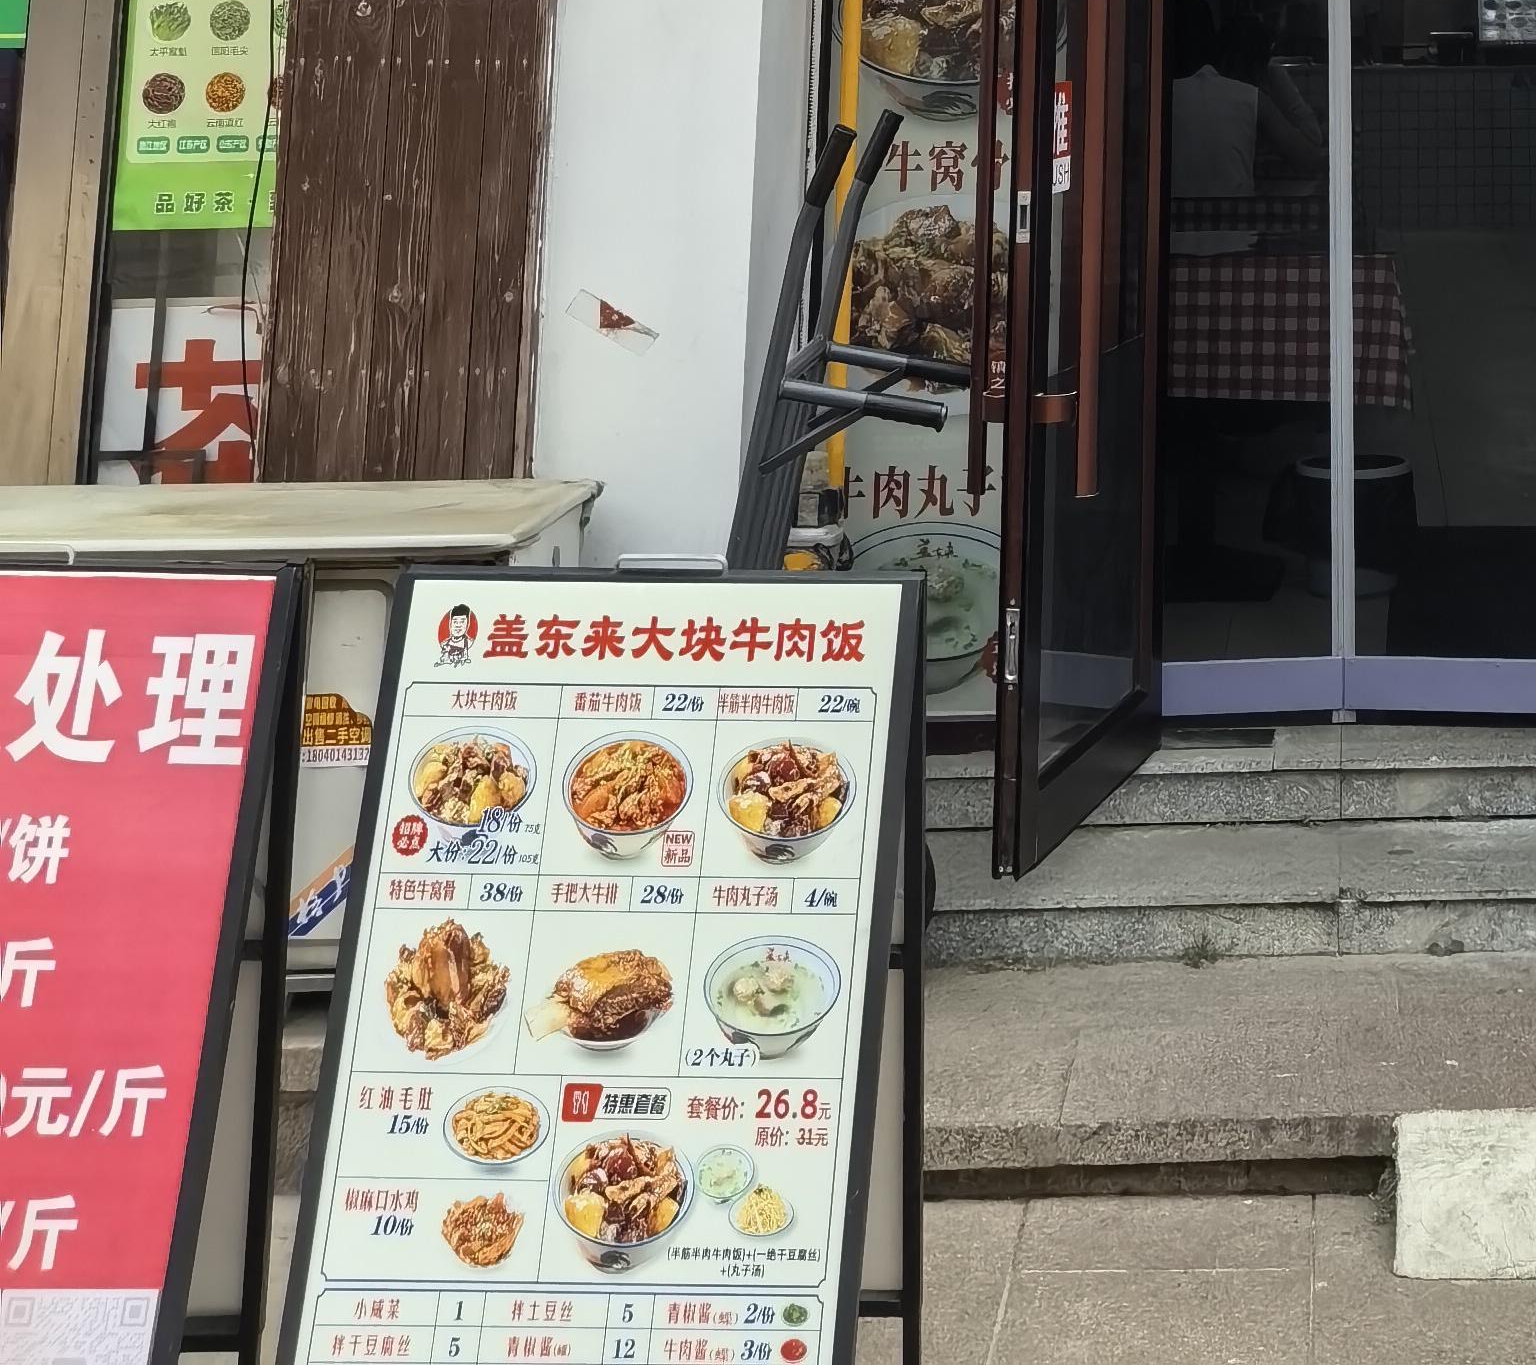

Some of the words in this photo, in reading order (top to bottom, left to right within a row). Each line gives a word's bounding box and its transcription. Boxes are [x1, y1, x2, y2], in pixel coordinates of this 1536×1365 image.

[154, 190, 235, 214] 品好茶
[482, 613, 866, 664] 盖东来大块牛肉饭
[6, 628, 256, 767] 处理
[451, 689, 519, 711] 大块牛肉饭
[574, 691, 643, 713] 番茄牛肉饭
[661, 692, 705, 713] 22/份
[302, 726, 371, 746] 出售二手空调
[666, 833, 693, 846] NEW
[664, 848, 692, 864] 新品
[389, 878, 457, 902] 特色牛窝骨
[551, 882, 618, 905] 手把大牛排
[712, 884, 779, 908] 牛肉丸子汤
[0, 1065, 168, 1140] 元/斤
[358, 1085, 434, 1111] 红油毛肚
[602, 1092, 668, 1116] 特惠套餐
[344, 1188, 420, 1212] 椒麻口水鸡
[354, 1297, 400, 1321] 小咸菜
[455, 1300, 464, 1321] 1
[511, 1299, 574, 1322] 拌土豆丝
[621, 1303, 634, 1323] 5
[331, 1334, 412, 1357] 拌干豆腐丝
[448, 1337, 461, 1357] 5
[611, 1338, 636, 1359] 12
